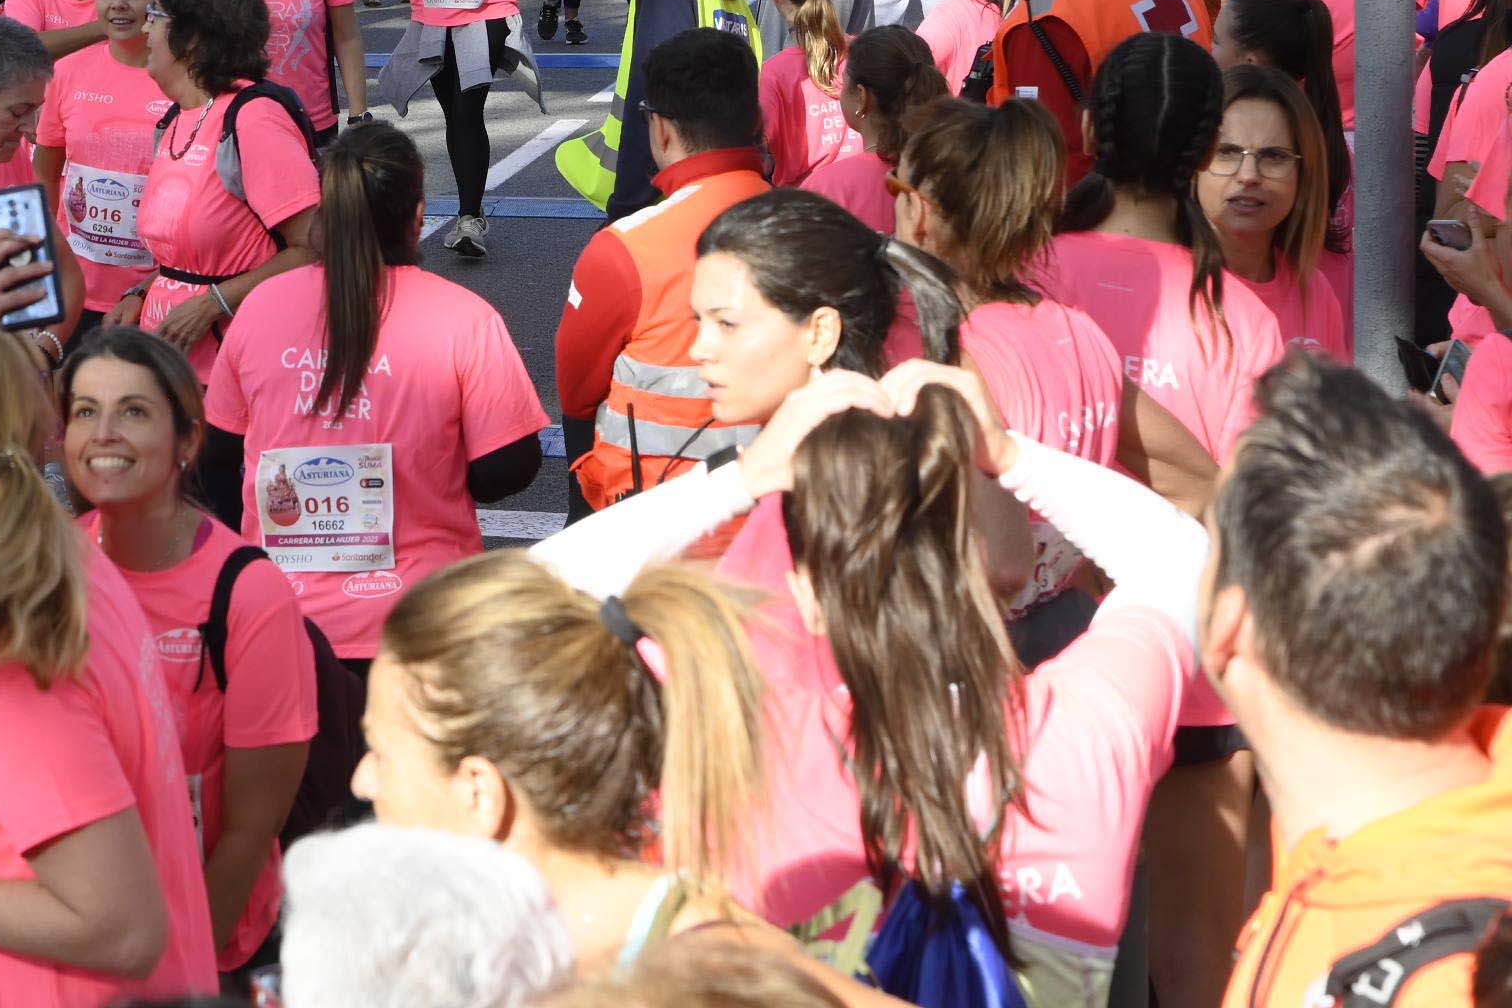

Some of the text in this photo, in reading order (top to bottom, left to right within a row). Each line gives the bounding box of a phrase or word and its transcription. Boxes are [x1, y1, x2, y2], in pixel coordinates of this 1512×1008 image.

[74, 91, 114, 104] OYSHO
[824, 118, 842, 130] DE
[89, 184, 128, 196] ASTURIANA
[88, 206, 122, 224] 016
[92, 223, 114, 234] 6294
[108, 237, 128, 246] MUJER
[113, 252, 146, 260] Santander
[358, 461, 382, 470] SUMA
[298, 466, 352, 480] ASTURIANA
[304, 496, 350, 514] 016
[312, 519, 344, 531] 16662
[278, 536, 314, 544] CARRERA
[315, 536, 324, 544] DE
[326, 536, 334, 544] LA
[336, 536, 360, 544] MUJER
[276, 552, 312, 564] OYSHO
[340, 551, 385, 562] Santander
[346, 580, 398, 592] ASTURIANA
